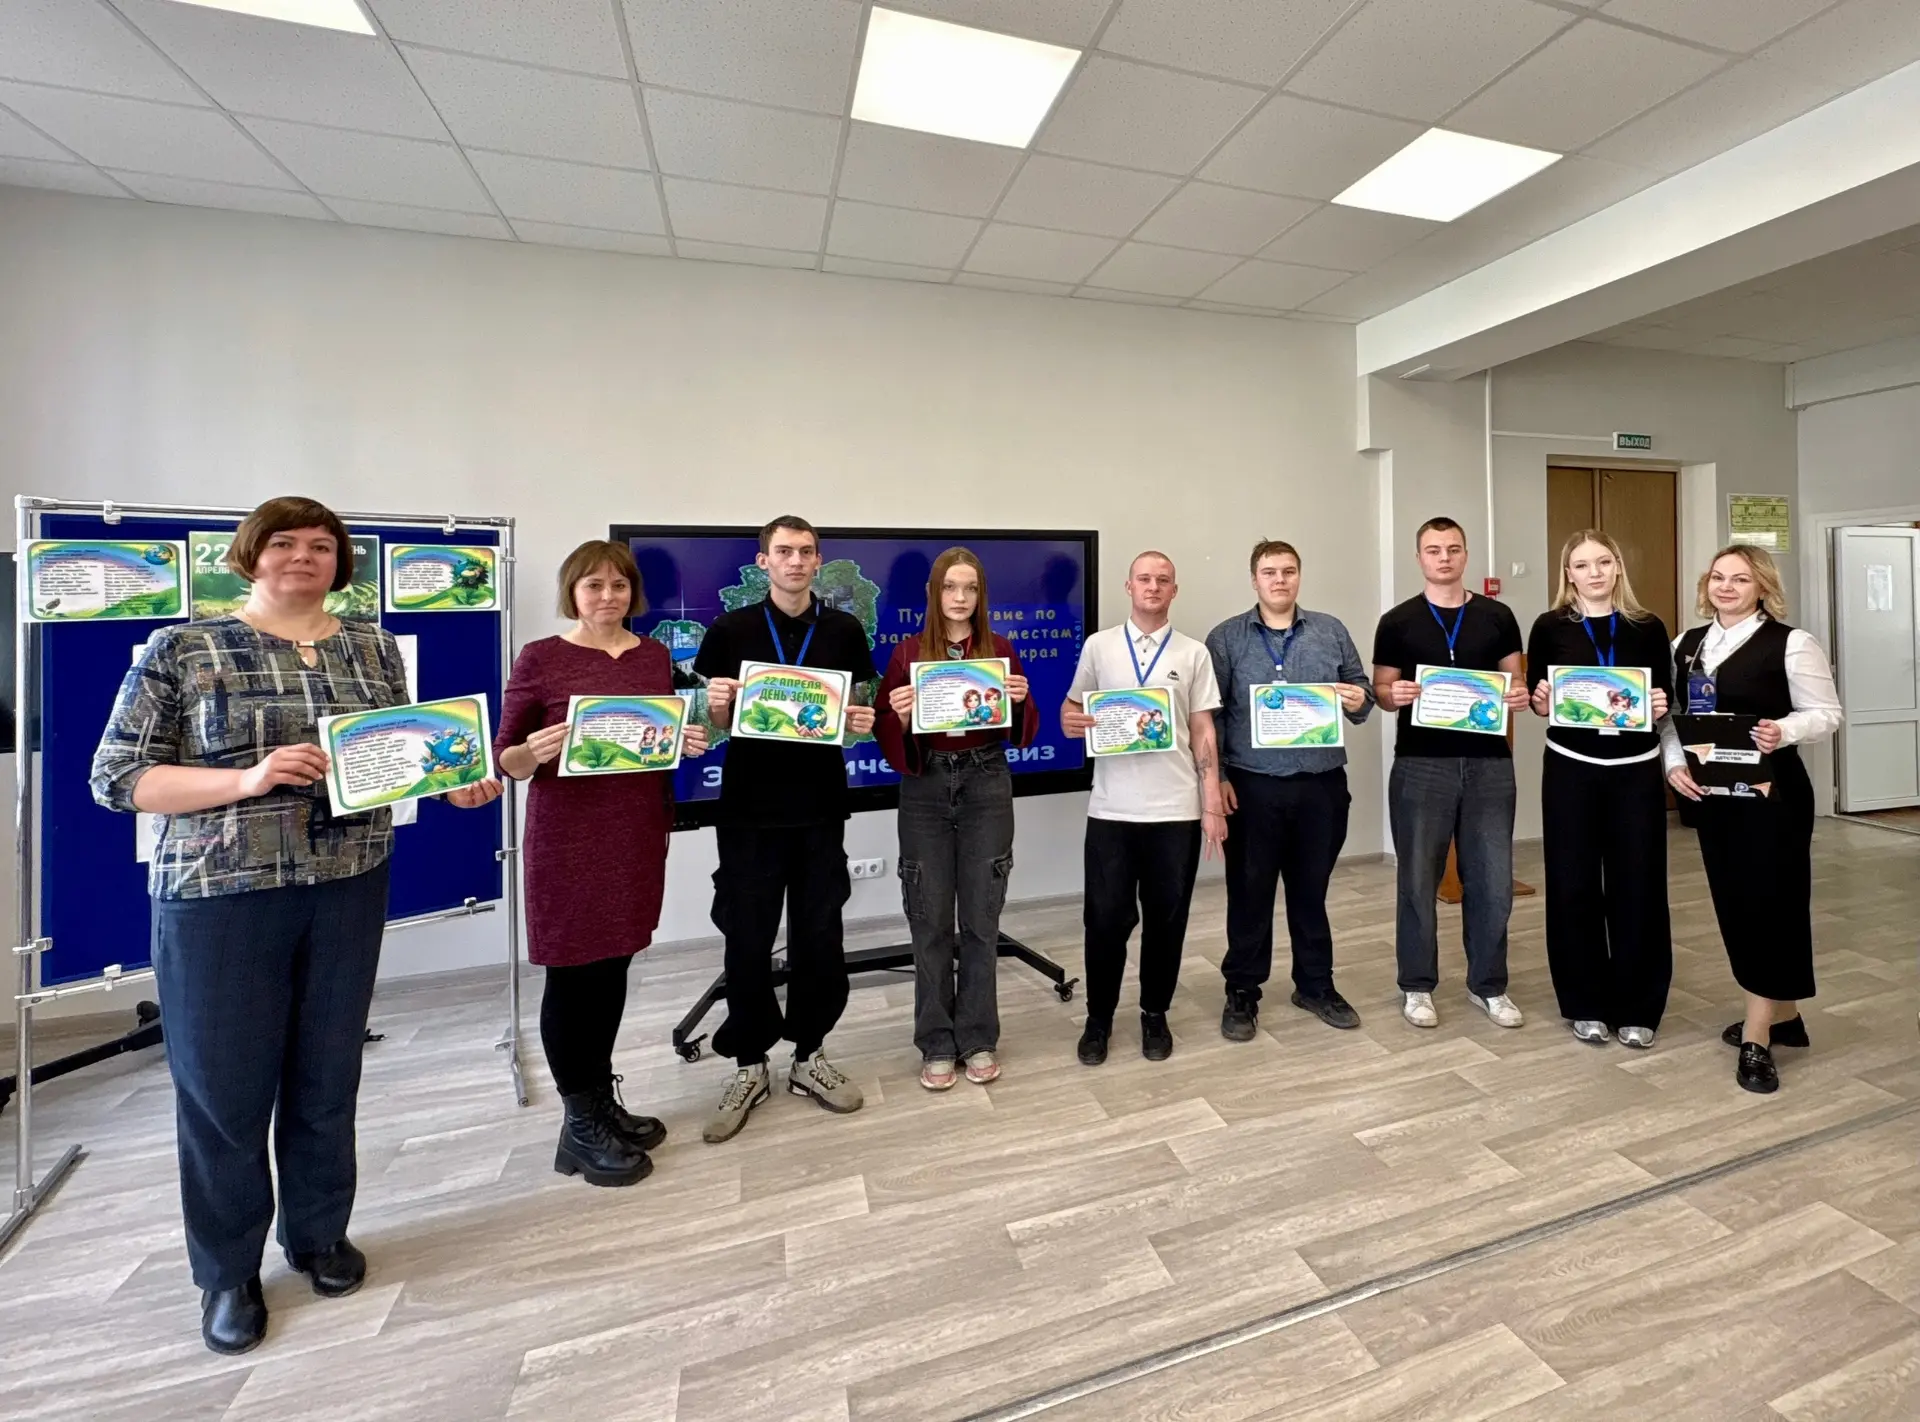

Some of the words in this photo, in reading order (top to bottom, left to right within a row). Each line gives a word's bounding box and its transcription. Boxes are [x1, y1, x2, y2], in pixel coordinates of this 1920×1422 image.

[1619, 436, 1650, 448] ВЫХОД
[195, 542, 230, 566] 22
[1035, 609, 1056, 621] по
[1007, 628, 1072, 641] местам
[1020, 647, 1058, 663] края
[763, 676, 778, 687] 22
[780, 677, 822, 690] АПРЕЛЯ
[758, 688, 787, 702] ДЕНЬ
[790, 690, 828, 705] ЗЕМЛИ
[1004, 745, 1055, 763] виз
